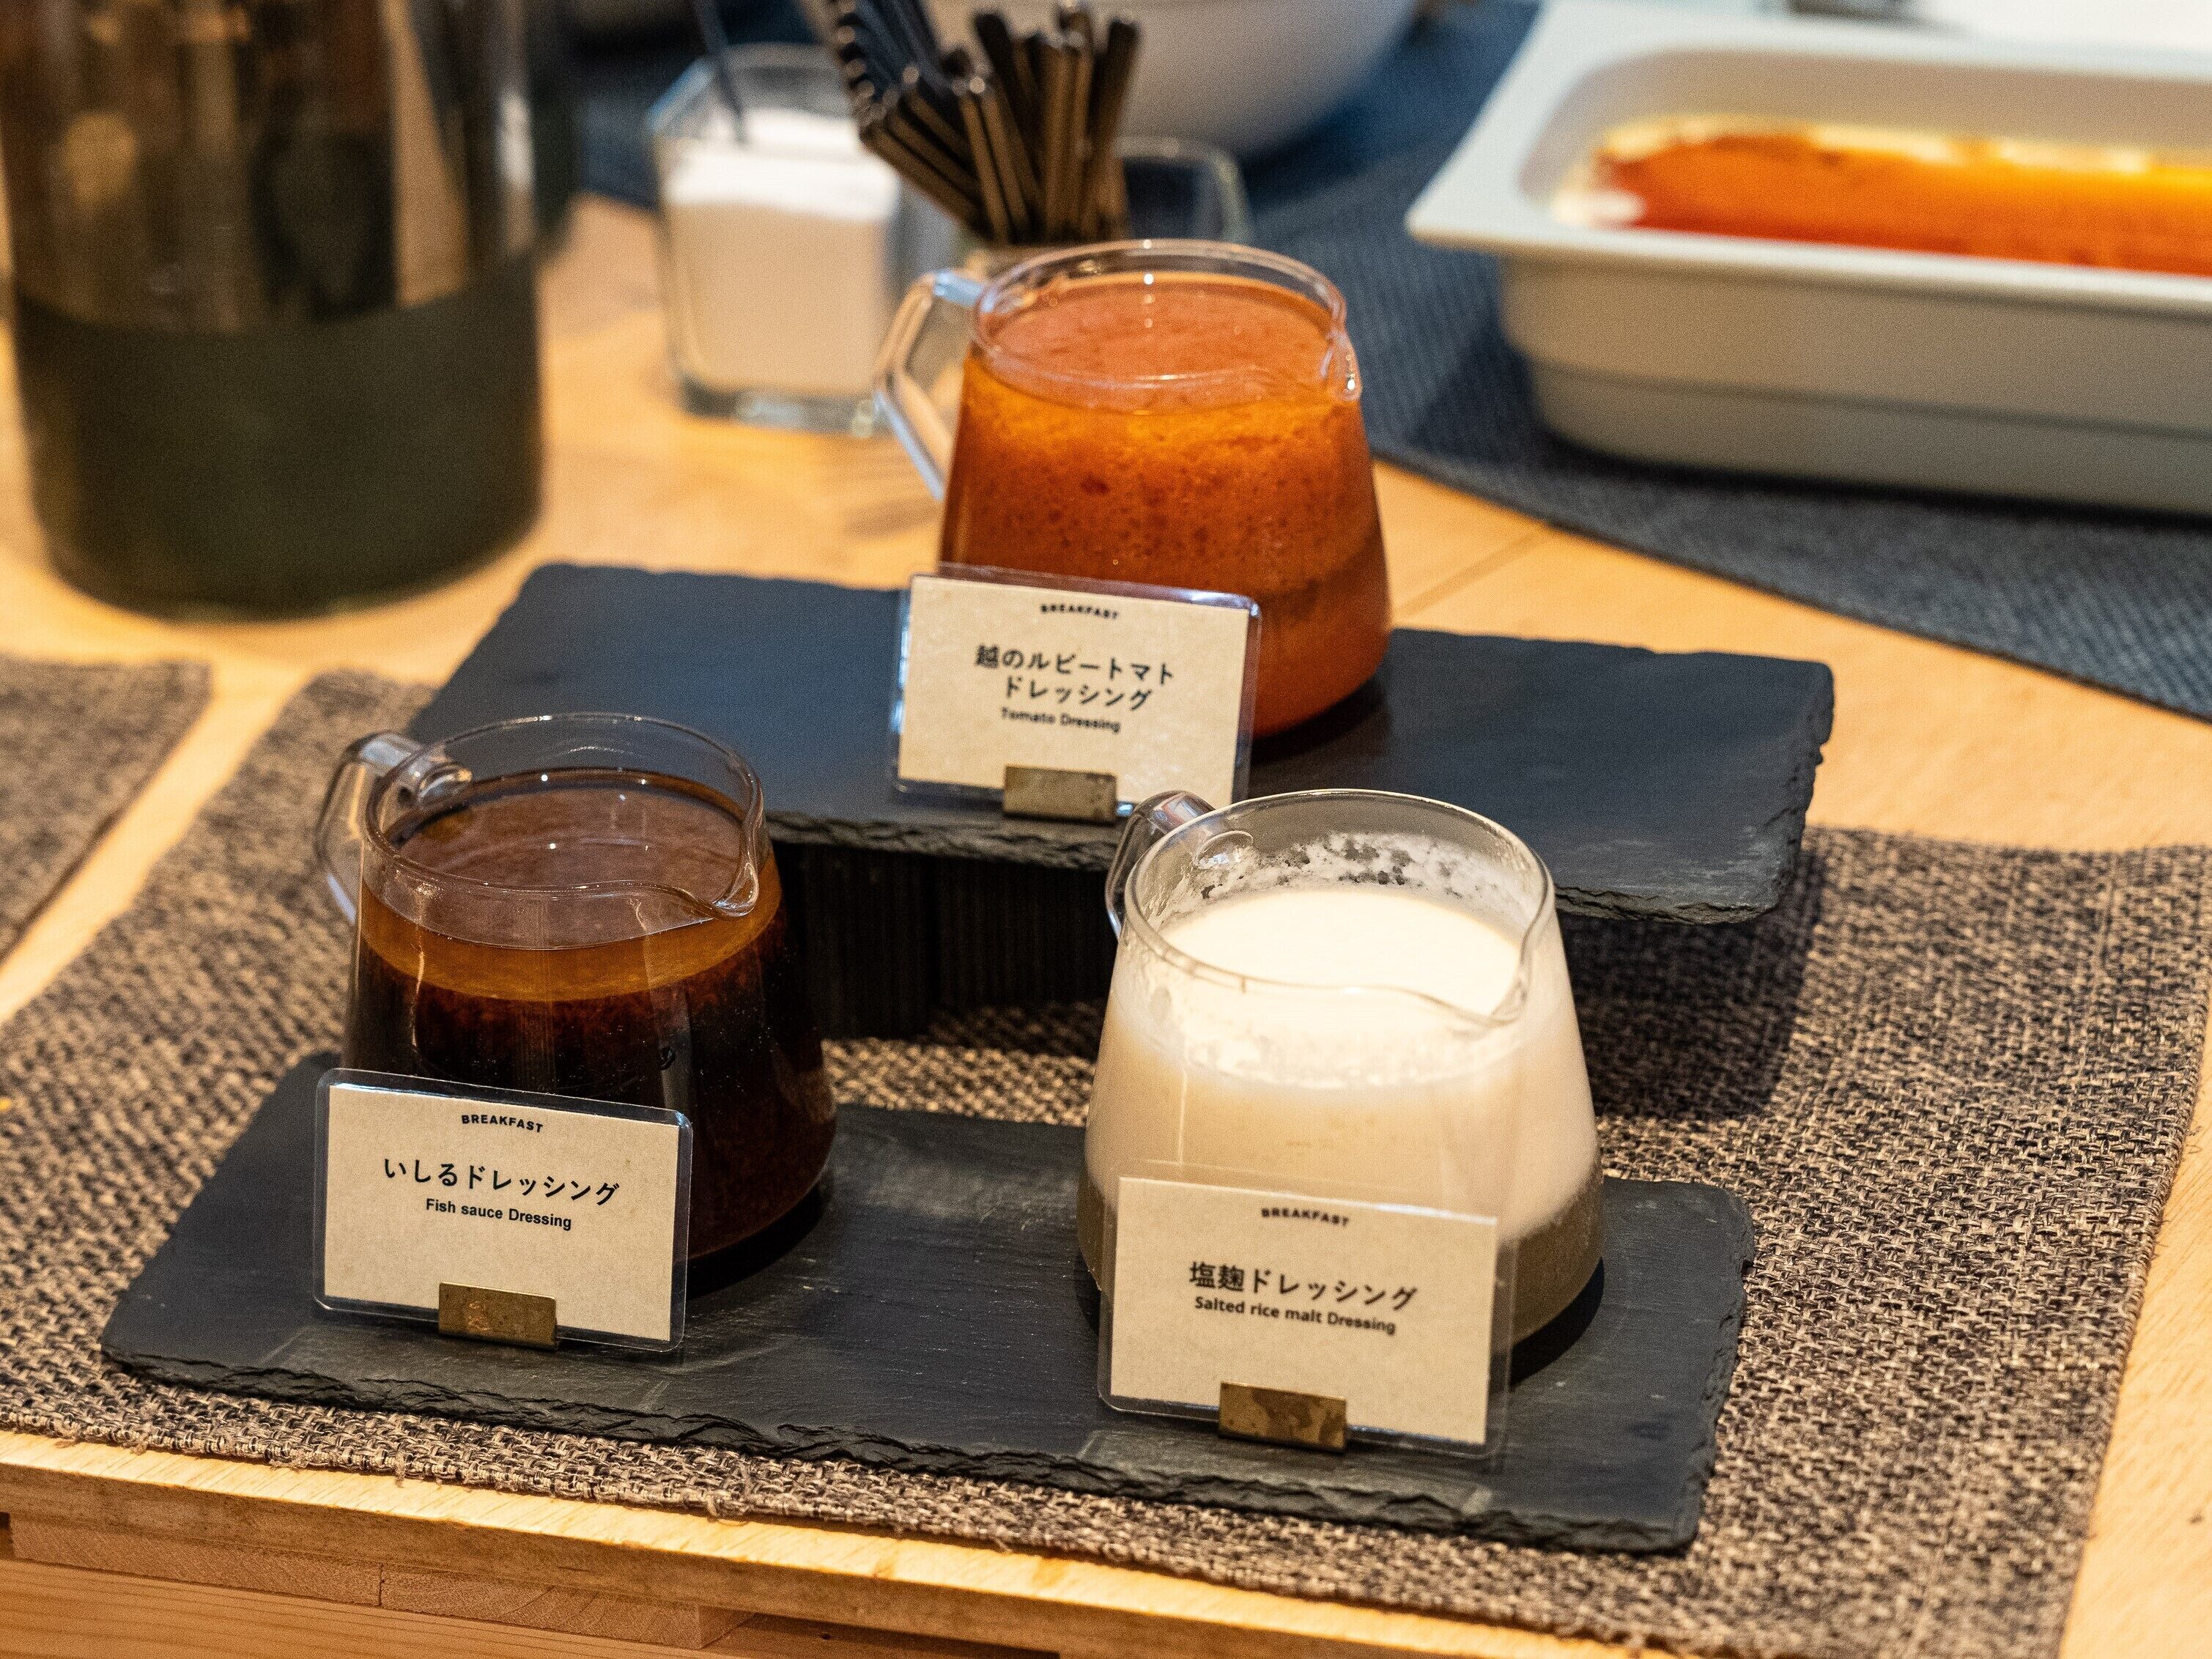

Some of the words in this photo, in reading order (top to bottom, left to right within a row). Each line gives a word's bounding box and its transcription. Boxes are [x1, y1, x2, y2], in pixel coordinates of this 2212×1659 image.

[974, 643, 1173, 685] 越のルビートマト
[1006, 675, 1153, 712] ドレッシング
[1001, 706, 1056, 725] Tomato
[1059, 712, 1122, 735] Dressing
[461, 1114, 544, 1134] BREAKFAST
[384, 1158, 620, 1206] いしるドレッシング
[426, 1197, 456, 1213] Fish
[460, 1204, 503, 1220] sauce
[508, 1208, 572, 1232] Dressing
[1260, 1208, 1350, 1226] BREAKFAST
[1188, 1260, 1418, 1312] 塩麹ドレッシング
[1194, 1296, 1246, 1315] Salted
[1250, 1303, 1280, 1320] rice
[1284, 1309, 1323, 1325] malt
[1326, 1311, 1397, 1337] Dressing
